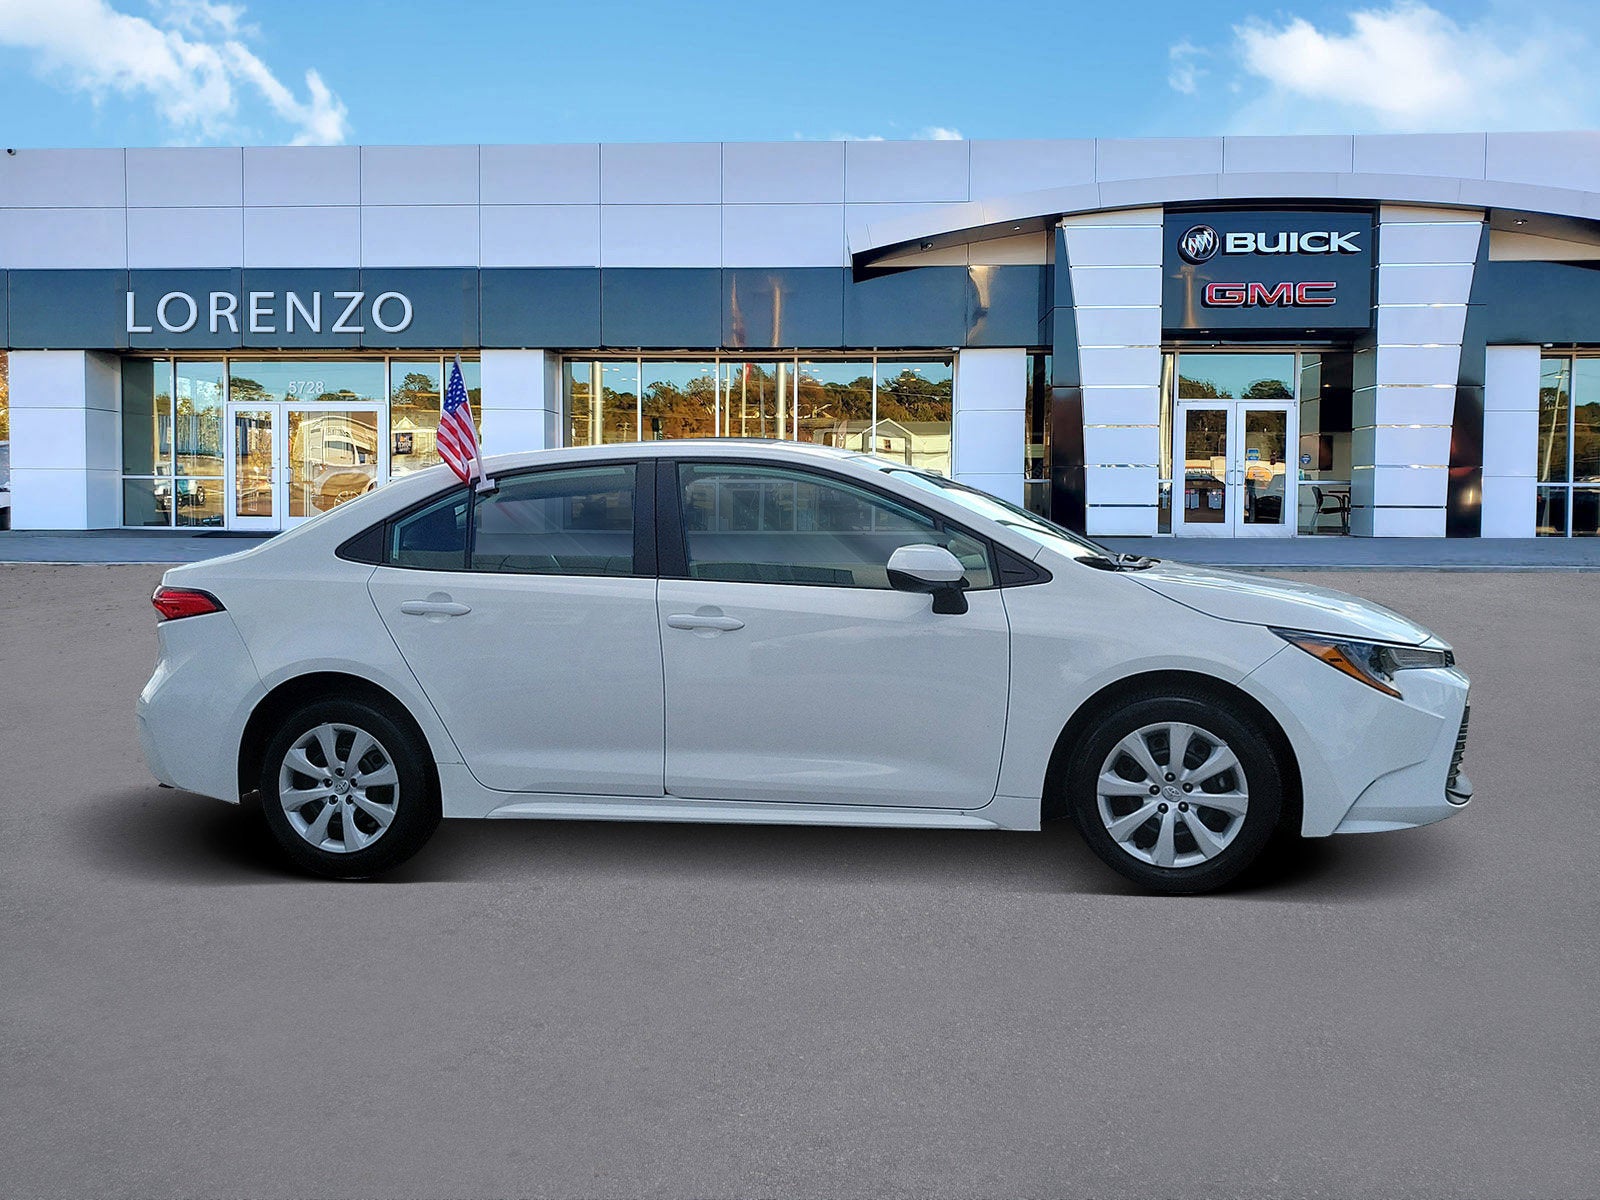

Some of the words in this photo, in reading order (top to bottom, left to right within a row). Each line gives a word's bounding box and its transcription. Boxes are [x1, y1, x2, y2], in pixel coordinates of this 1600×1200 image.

[1225, 231, 1362, 253] BUICK
[1206, 282, 1337, 305] GMC
[126, 291, 413, 333] LORENZO
[288, 381, 324, 394] 5728
